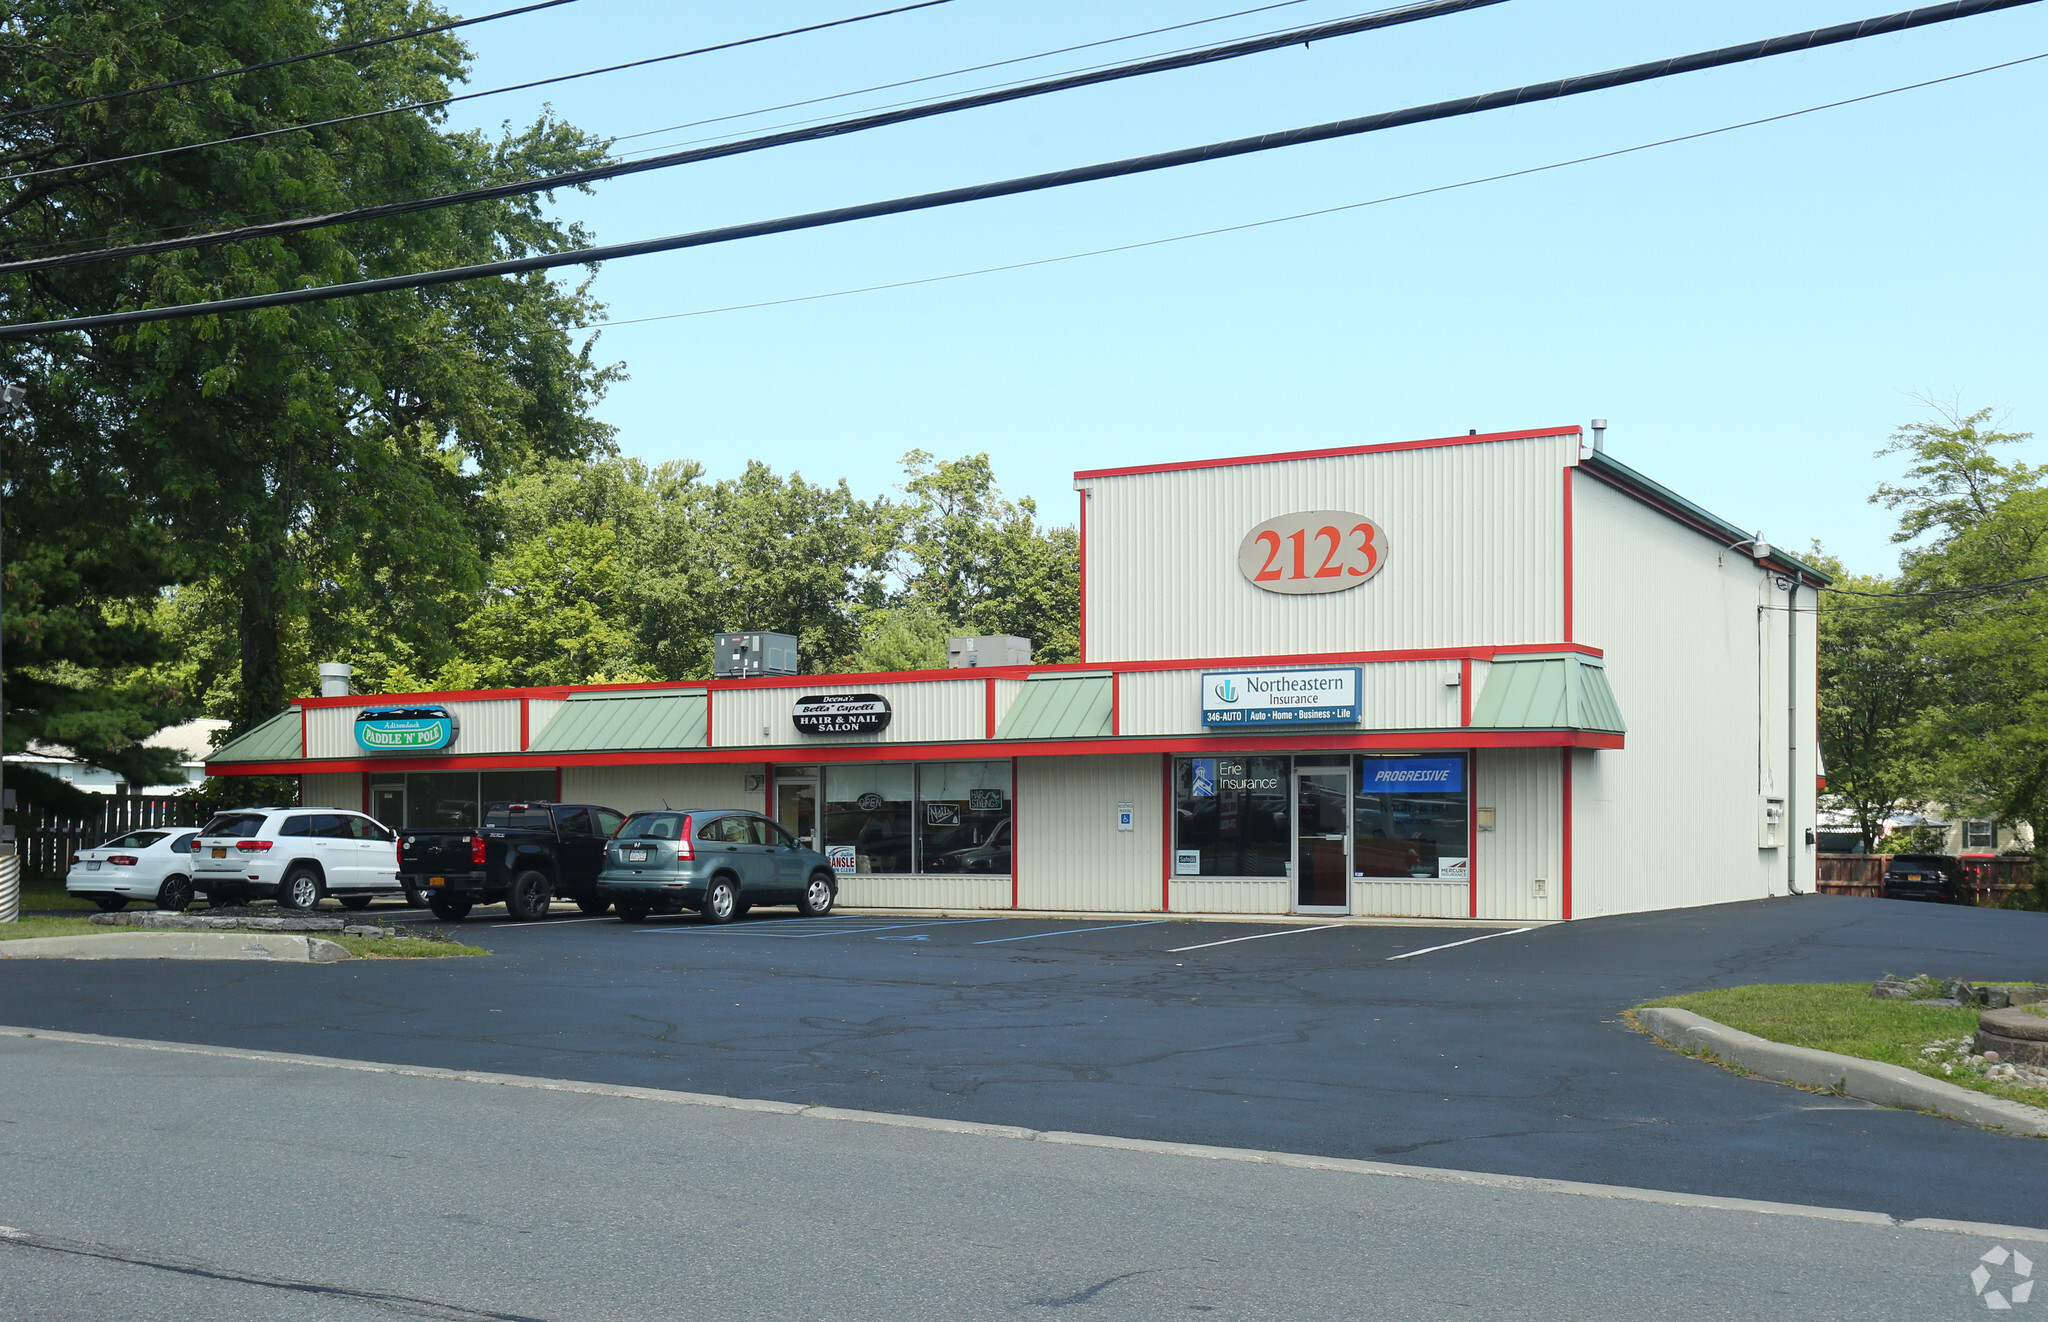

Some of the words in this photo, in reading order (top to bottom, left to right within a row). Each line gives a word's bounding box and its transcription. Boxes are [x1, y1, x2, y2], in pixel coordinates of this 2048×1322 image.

[1253, 522, 1378, 582] 2123
[1246, 676, 1343, 693] Northeastern
[822, 695, 855, 703] Deena's
[1269, 693, 1319, 705] Insurance
[836, 703, 875, 713] Capelli
[800, 716, 832, 725] HAIR
[835, 716, 845, 724] &
[848, 715, 879, 723] NAIL
[1206, 711, 1242, 722] 346-AUTO
[1250, 711, 1266, 721] Auto
[1272, 710, 1293, 720] Home
[1298, 709, 1331, 719] Business
[1336, 708, 1351, 718] Life
[384, 721, 421, 729] Adirondack
[818, 723, 860, 732] SALON
[365, 728, 402, 744] PADDLE
[404, 733, 416, 743] 'N'
[417, 726, 440, 743] POLE
[1219, 761, 1242, 776] Erie
[1374, 769, 1450, 782] PROGRESSIVE
[1220, 777, 1278, 790] Insurance
[858, 798, 882, 808] OPEN
[929, 806, 953, 822] Nails
[826, 857, 855, 868] ANSLE
